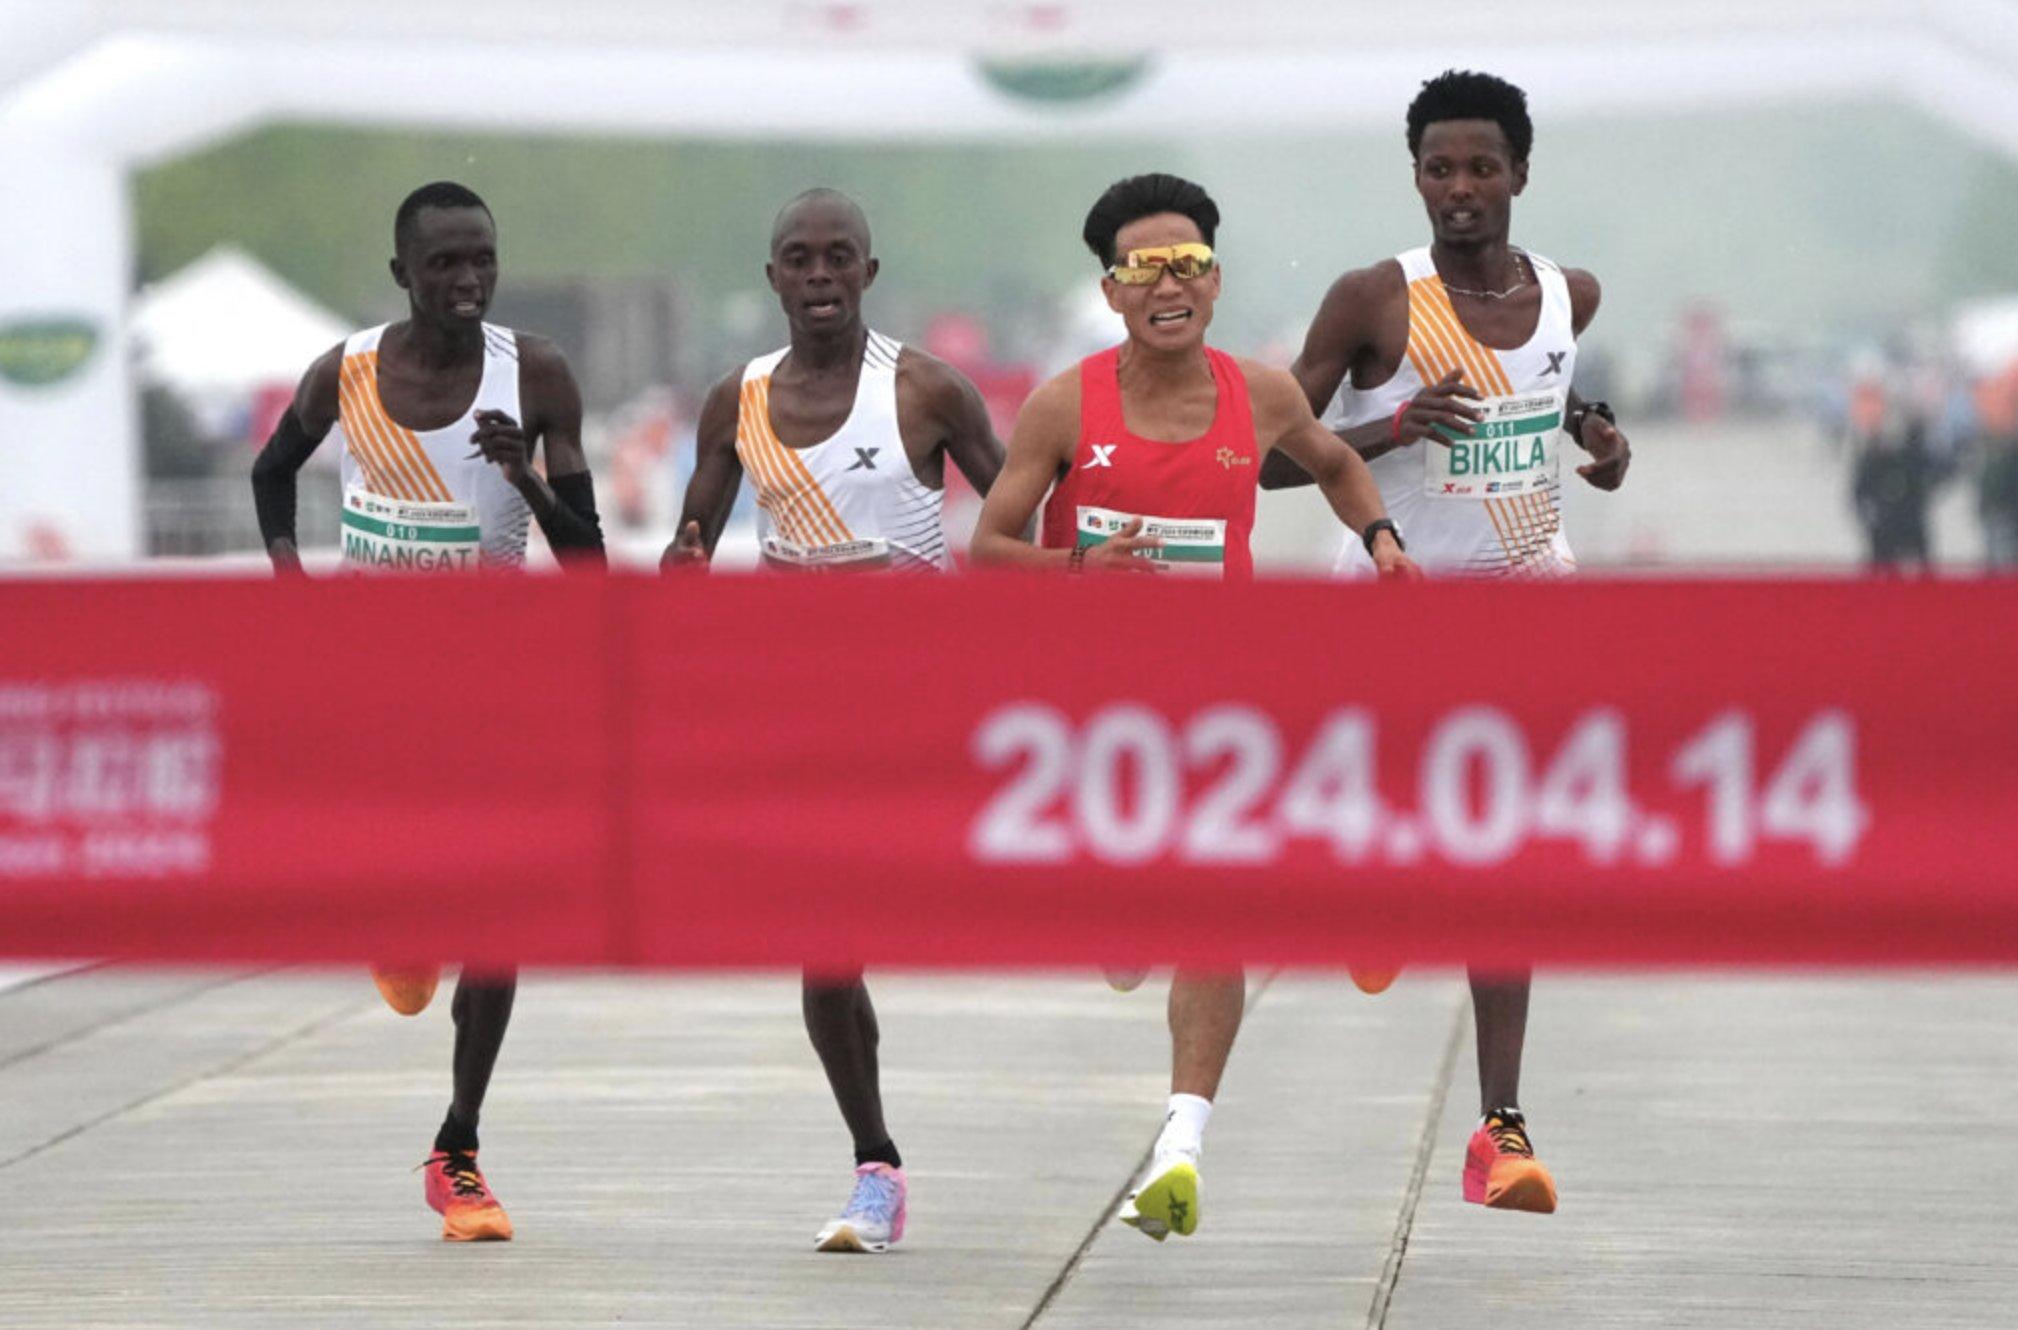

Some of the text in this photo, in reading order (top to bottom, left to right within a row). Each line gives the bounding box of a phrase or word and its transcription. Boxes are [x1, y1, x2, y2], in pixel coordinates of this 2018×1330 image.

[1485, 422, 1515, 438] 011
[1449, 436, 1545, 476] BIKILA
[386, 523, 418, 540] 010
[345, 532, 472, 572] MNANGAT
[970, 702, 1868, 867] 2024.04.14
